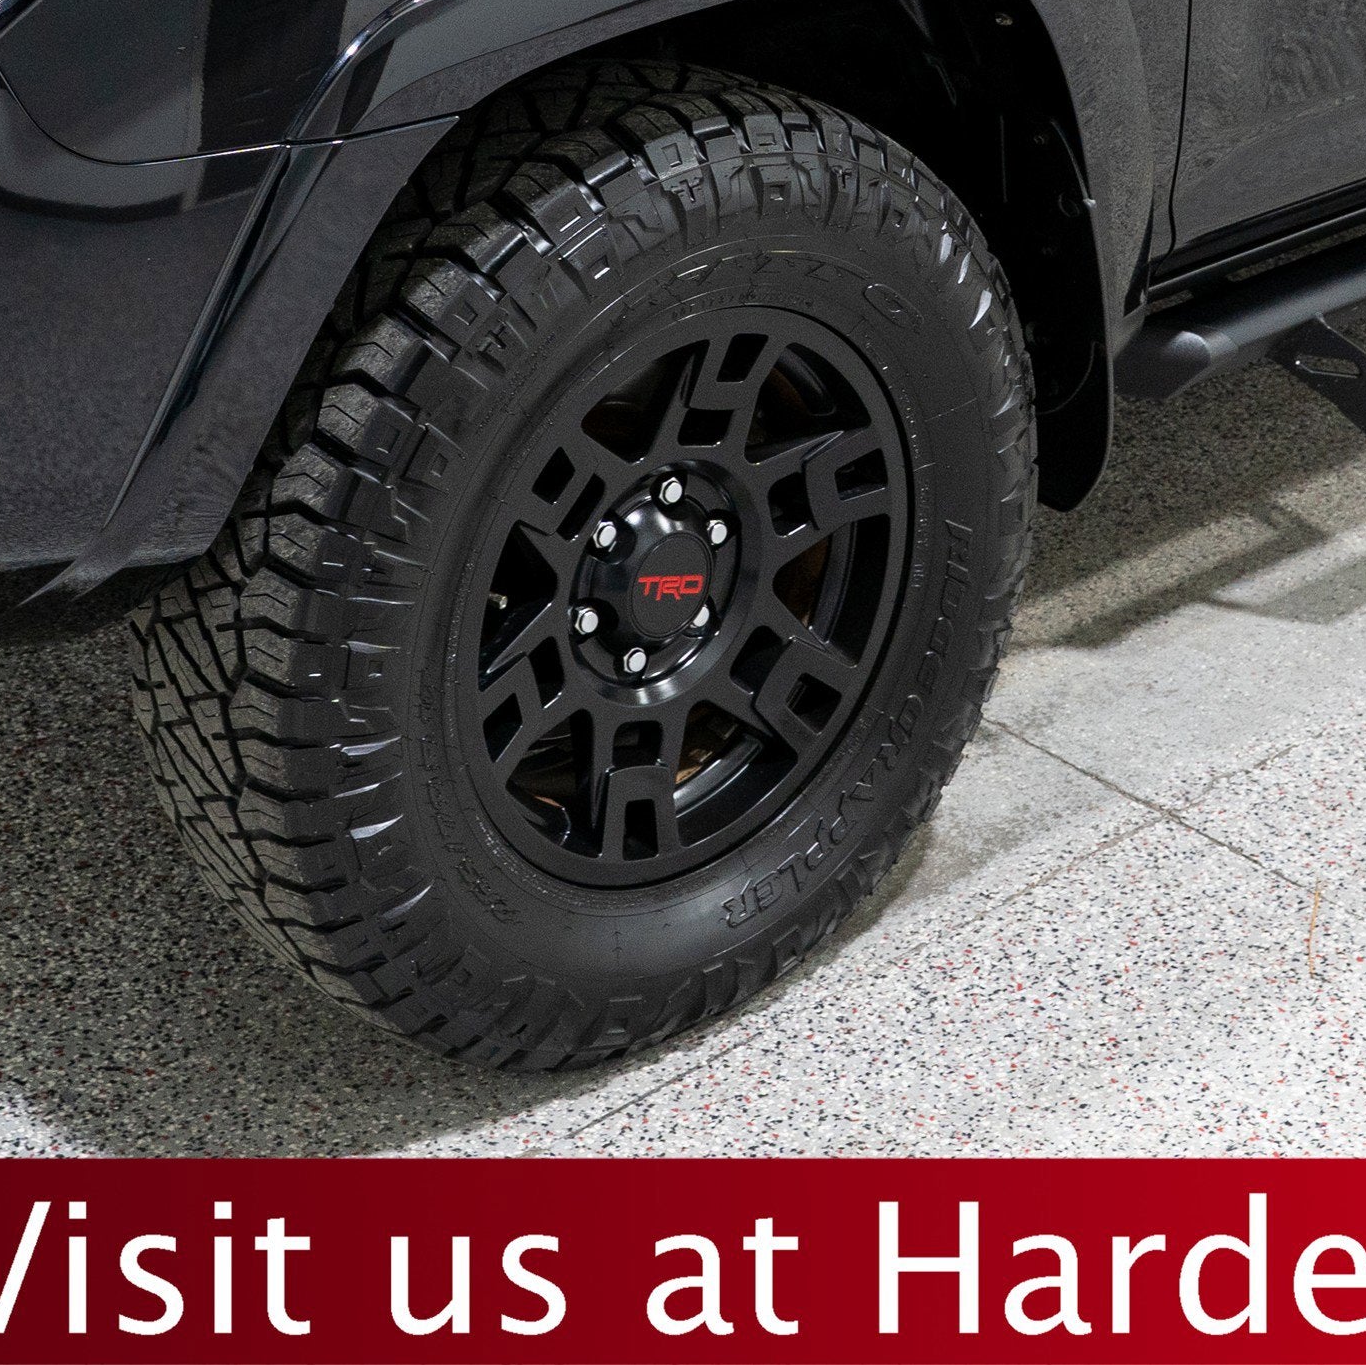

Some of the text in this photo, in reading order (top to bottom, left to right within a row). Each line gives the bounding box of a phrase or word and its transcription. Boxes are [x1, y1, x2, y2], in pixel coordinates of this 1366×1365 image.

[638, 574, 704, 601] TRD
[916, 518, 974, 695] RIDGE
[721, 693, 925, 929] GRAPPLER
